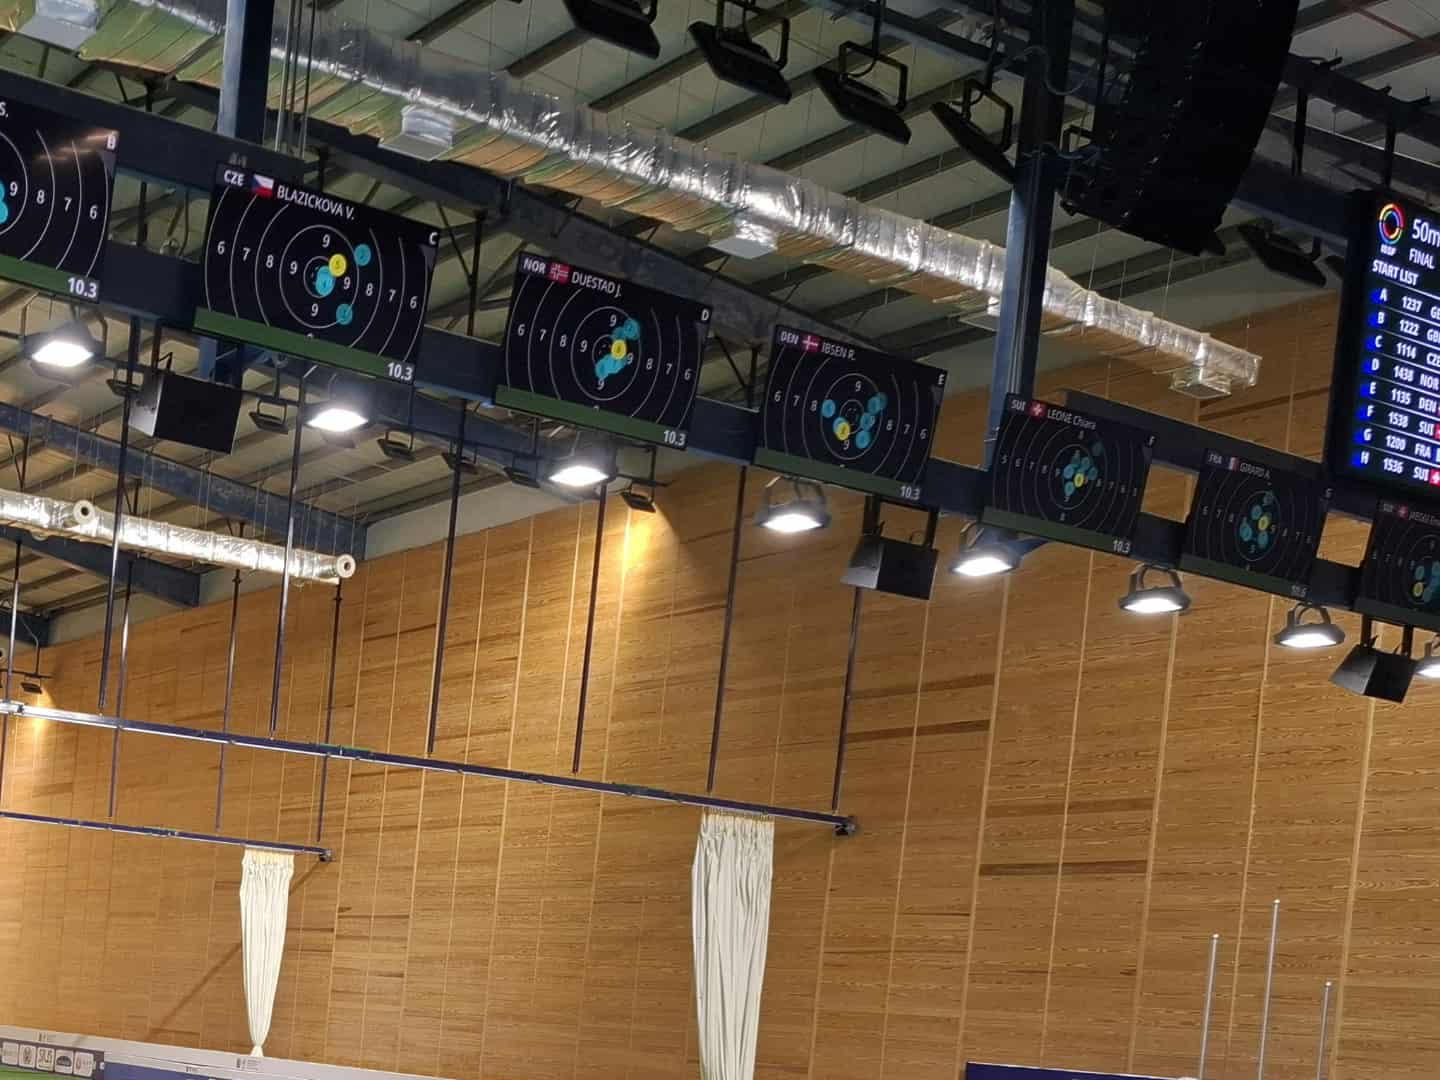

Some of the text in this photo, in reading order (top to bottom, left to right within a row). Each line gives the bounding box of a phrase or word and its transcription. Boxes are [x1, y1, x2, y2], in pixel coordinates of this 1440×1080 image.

[10, 182, 18, 196] 9
[37, 190, 45, 204] 8
[64, 197, 72, 211] 7
[90, 204, 98, 219] 6
[224, 170, 355, 220] CZE BLAZICKOVA V.
[322, 235, 330, 248] 9
[429, 232, 437, 244] C
[1409, 248, 1435, 269] FINAL
[217, 241, 417, 309] 6 7 8 9 9 8 7 6
[523, 259, 545, 274] NOR
[571, 272, 615, 293] DUESTAD
[1372, 259, 1419, 286] START LIST
[68, 277, 97, 297] 10.3
[311, 304, 318, 317] 9
[1380, 288, 1388, 301] A
[1402, 296, 1422, 313] 1237
[610, 315, 617, 327] 9
[702, 309, 709, 321] D
[1377, 312, 1385, 324] B
[1400, 319, 1419, 336] 1222
[780, 331, 799, 344] DEN
[1375, 336, 1382, 348] C
[518, 324, 691, 380] 6 7 8 9 9 8 7 6
[387, 362, 413, 381] 10.3
[1371, 358, 1380, 371] D
[1420, 373, 1439, 391] NOR
[597, 379, 604, 390] 9
[774, 390, 782, 402] 6
[793, 395, 800, 407] 7
[1370, 382, 1376, 395] E
[1418, 397, 1437, 413] DEN
[1367, 405, 1374, 417] F
[1418, 421, 1434, 436] SUI
[663, 429, 686, 446] 10.3
[1363, 428, 1372, 441] G
[1415, 443, 1431, 459] FRA
[1361, 451, 1370, 465] H
[1413, 466, 1429, 482] SUI
